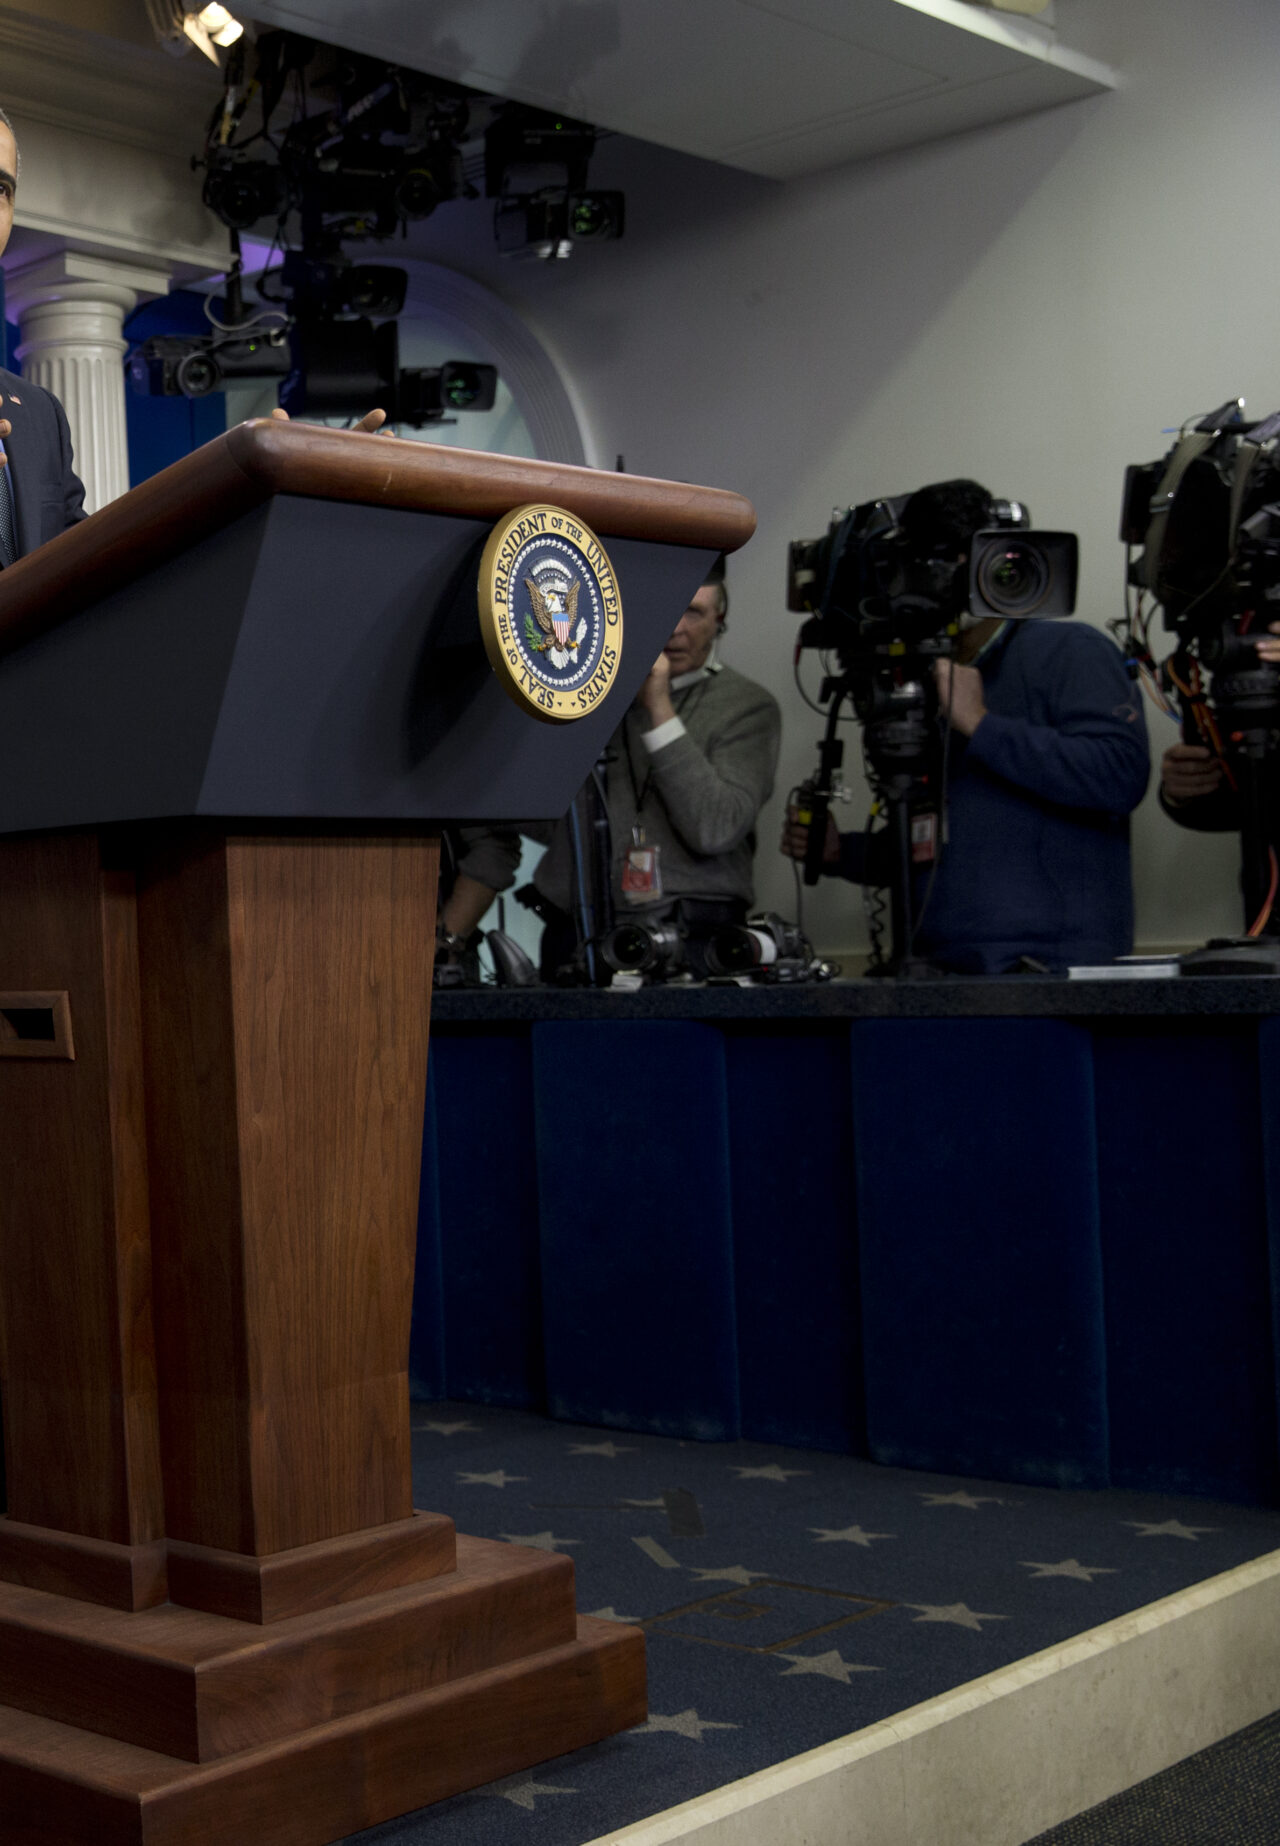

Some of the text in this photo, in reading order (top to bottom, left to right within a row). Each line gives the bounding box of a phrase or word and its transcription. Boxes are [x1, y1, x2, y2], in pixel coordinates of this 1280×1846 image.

[495, 513, 619, 709] SEAL OF THE PRESIDENT OF THE UNITED STATES
